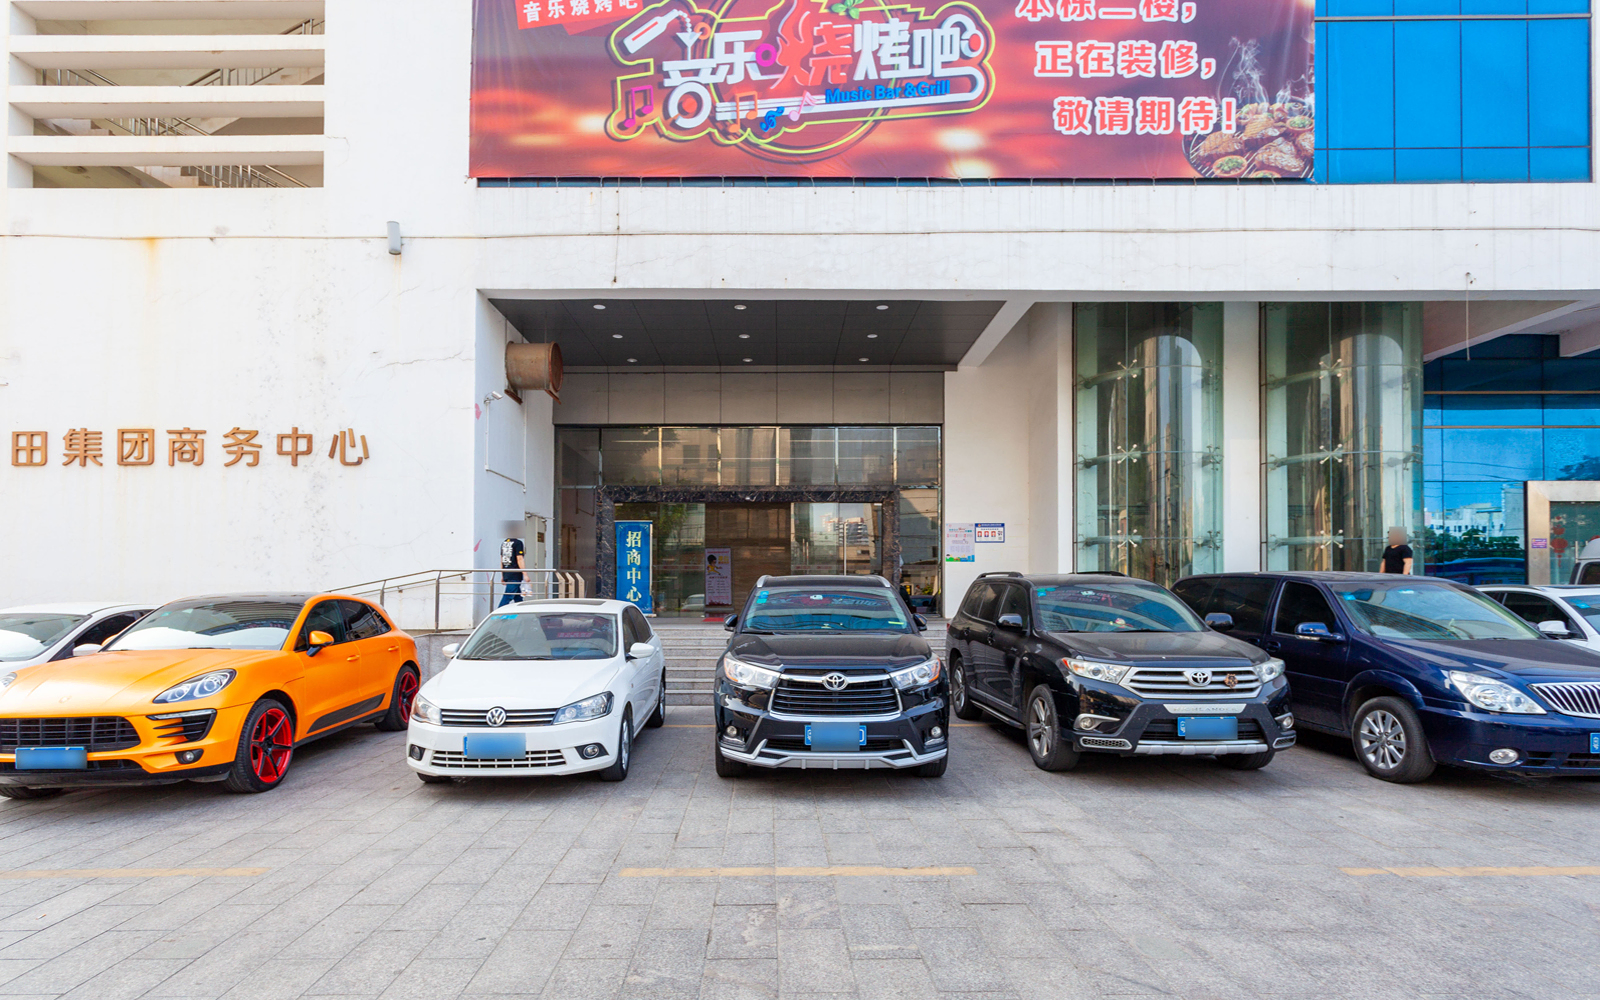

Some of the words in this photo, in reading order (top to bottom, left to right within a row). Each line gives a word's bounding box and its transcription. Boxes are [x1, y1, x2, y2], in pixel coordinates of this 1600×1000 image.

[825, 86, 872, 103] Music
[874, 84, 902, 100] Bar
[11, 427, 370, 467] 田集团商务中心
[625, 530, 642, 602] 招商中心
